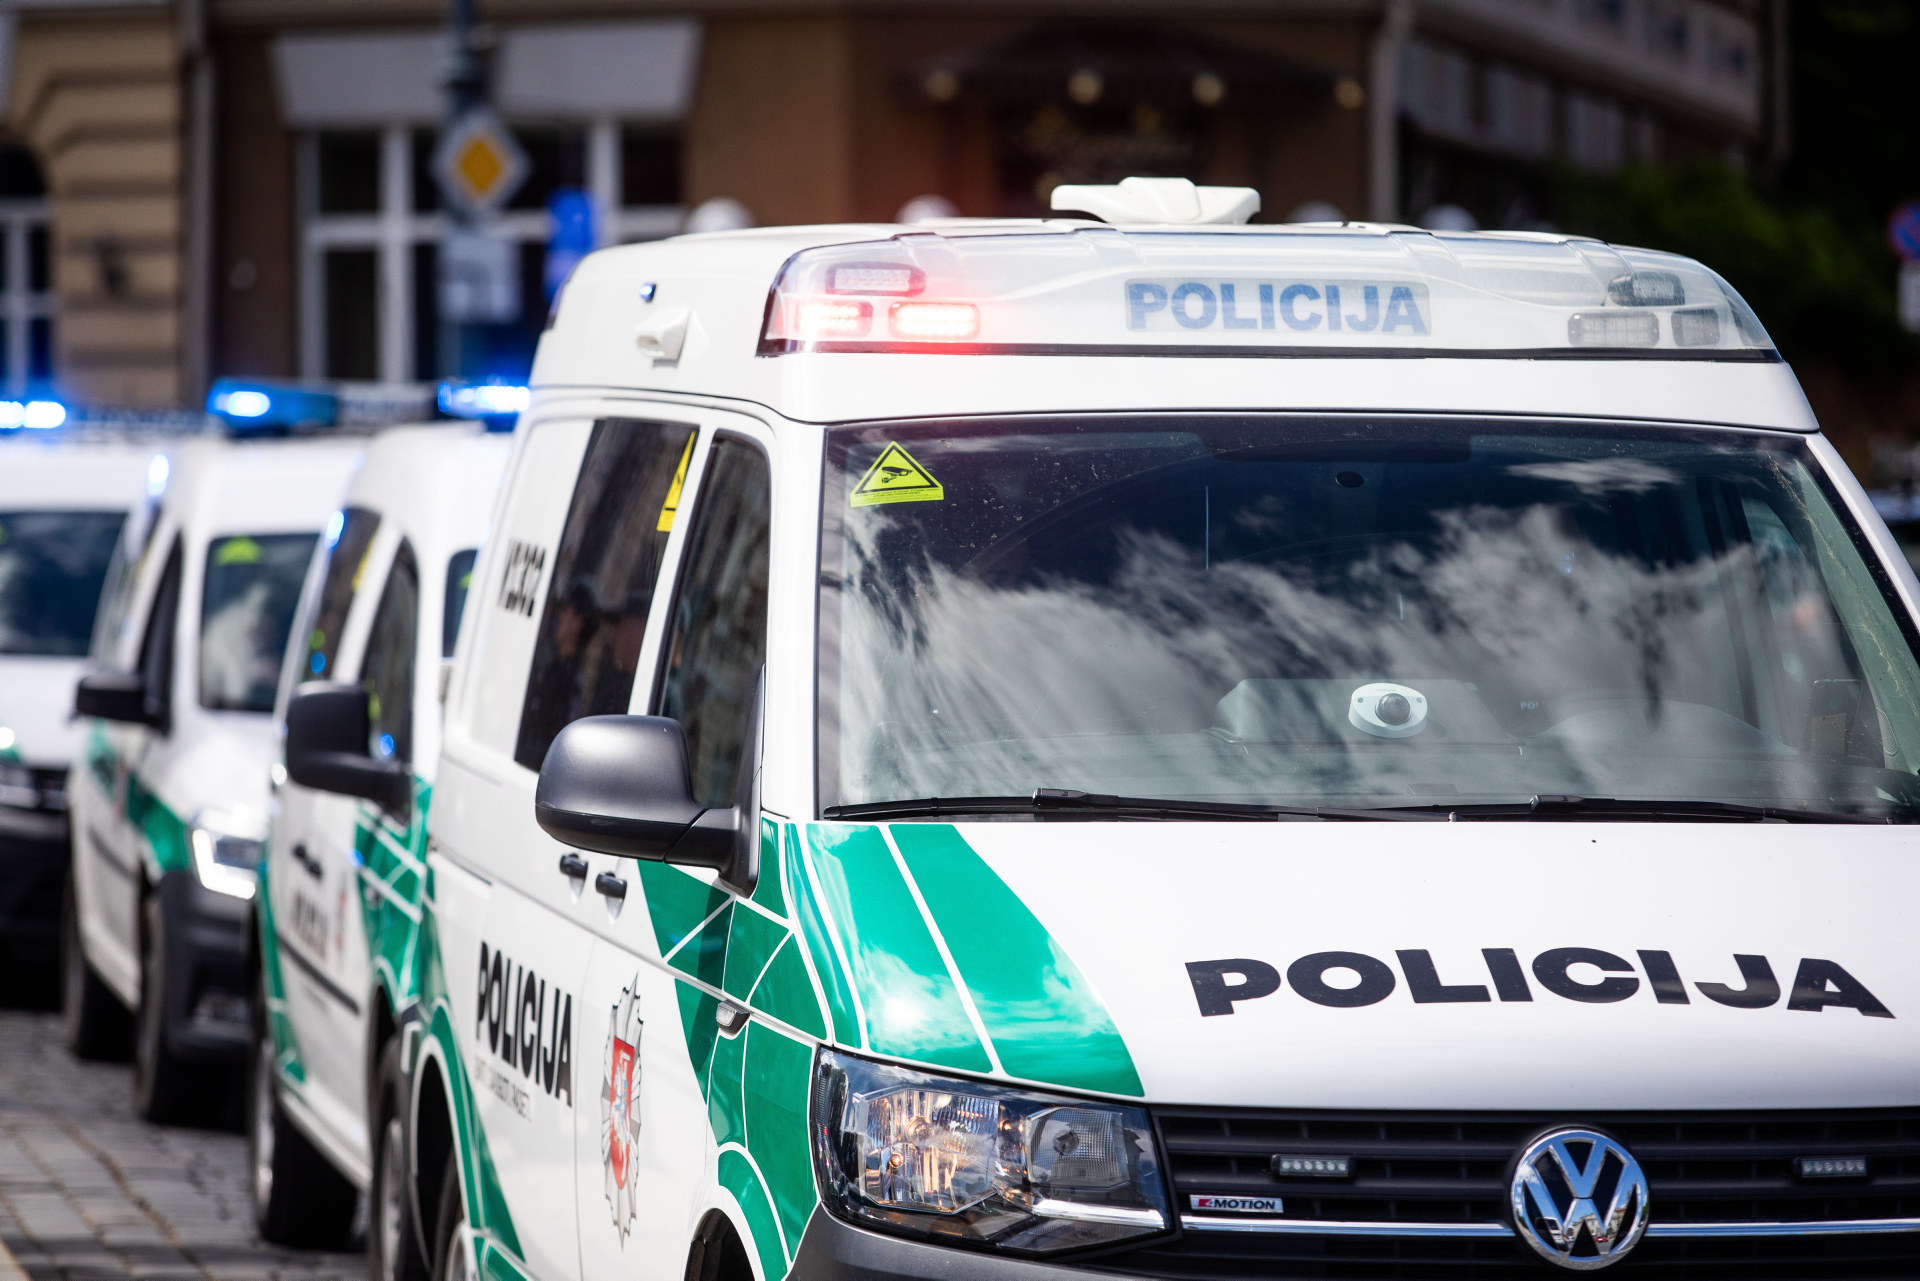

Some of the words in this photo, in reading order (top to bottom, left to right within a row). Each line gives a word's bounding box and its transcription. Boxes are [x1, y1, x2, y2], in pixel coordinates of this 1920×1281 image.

[1128, 282, 1428, 334] POLICIJA
[1184, 946, 1897, 1020] POLICIJA
[476, 940, 573, 1108] POLICIJA
[1198, 1198, 1276, 1210] 4MOTION
